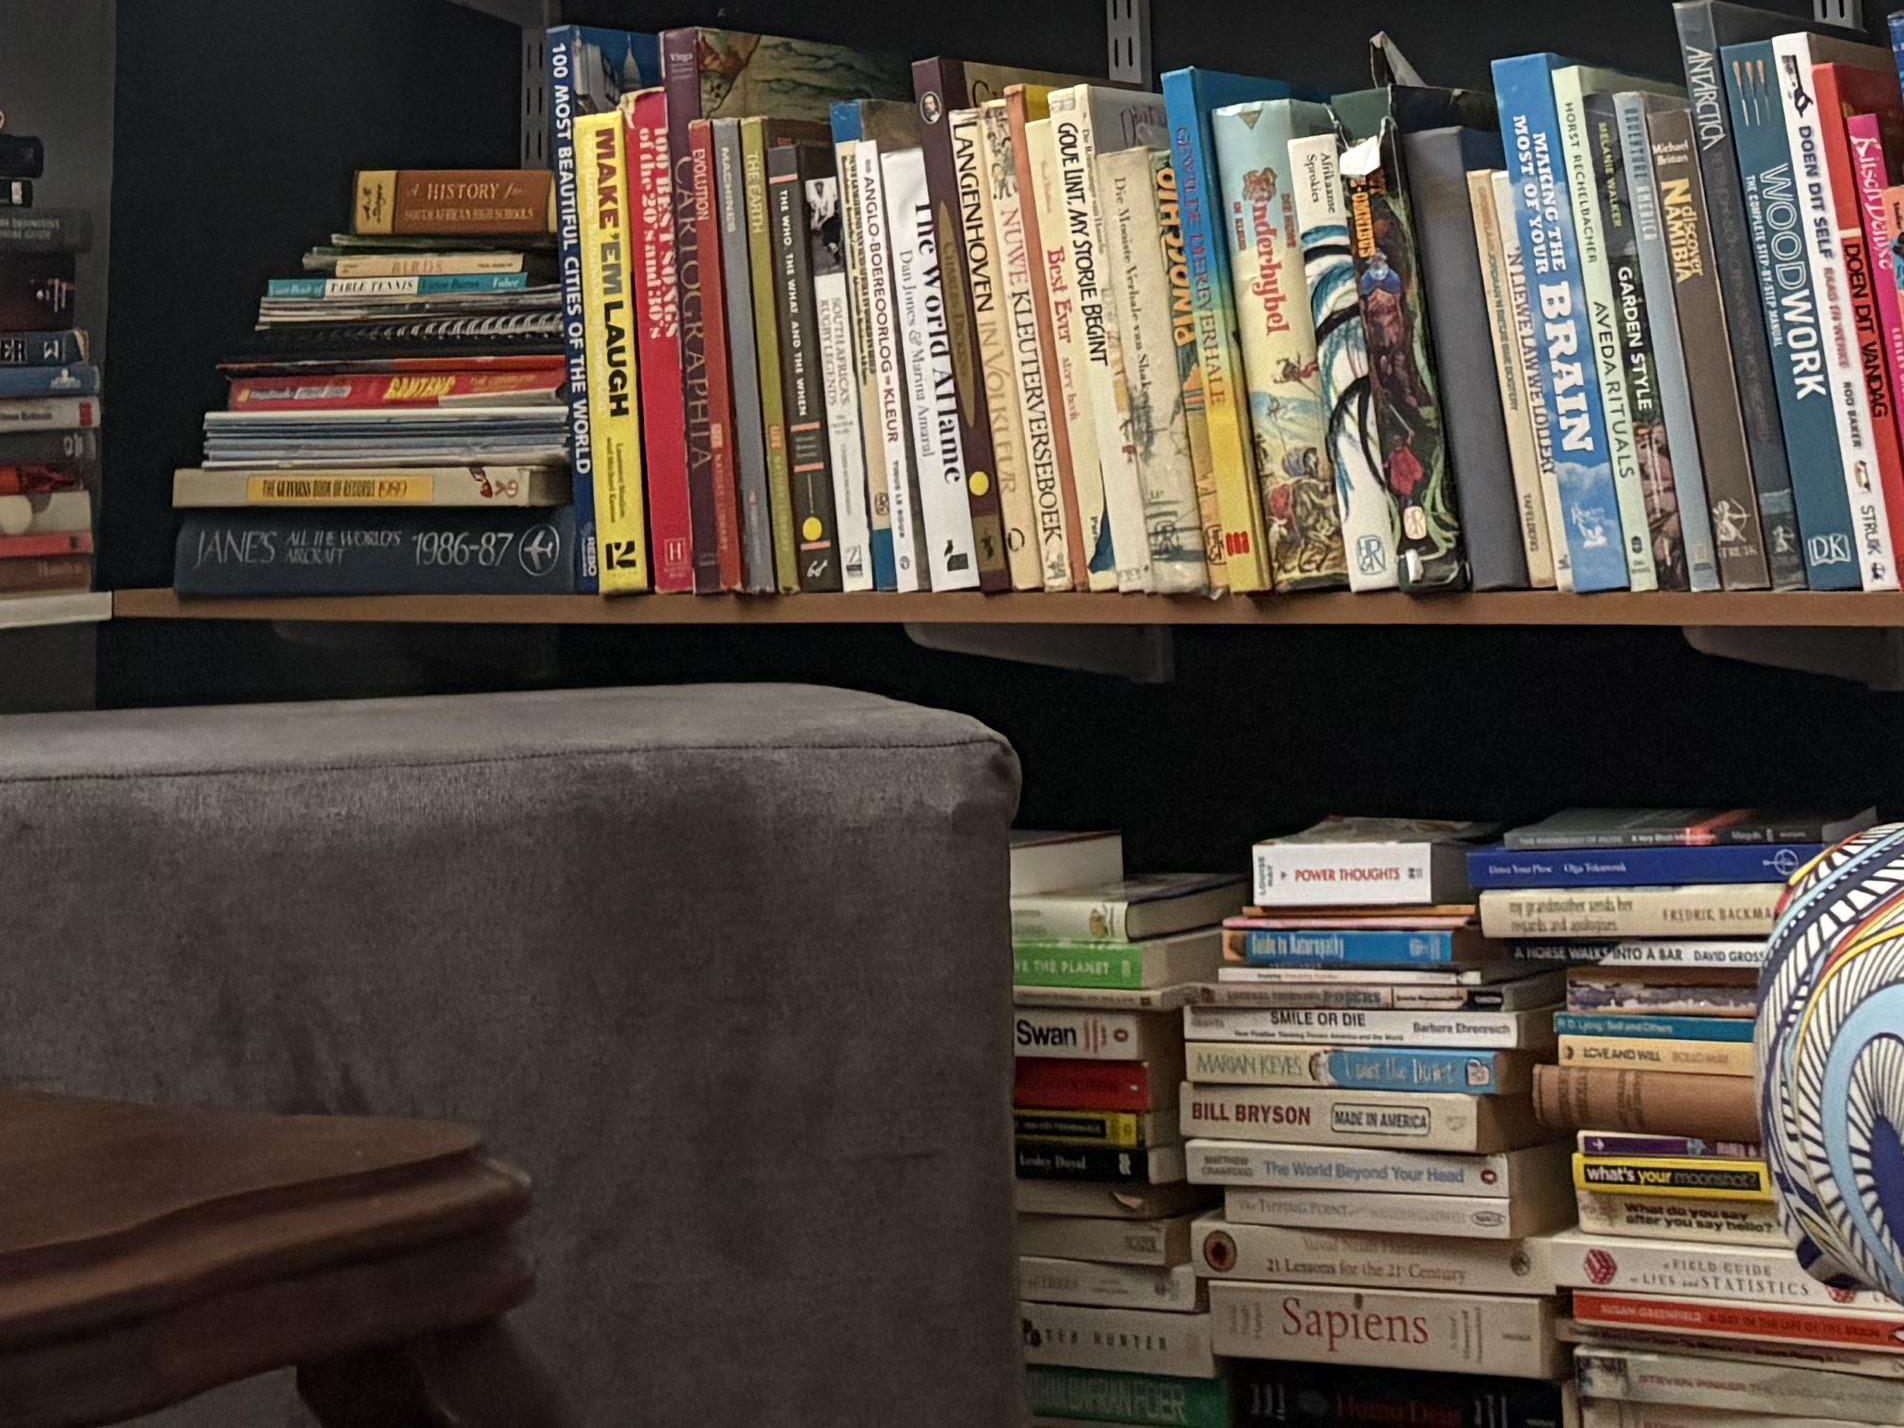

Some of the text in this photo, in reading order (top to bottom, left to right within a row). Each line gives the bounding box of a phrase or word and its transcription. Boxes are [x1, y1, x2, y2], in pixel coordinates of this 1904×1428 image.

[953, 122, 994, 314] LANGENHOVEN
[595, 127, 630, 418] MAKE 'EM LAUGH
[1759, 162, 1828, 400] WOODWORK
[1617, 265, 1653, 412] GARDEN STYLE
[1538, 281, 1594, 454] BRAIN
[1592, 300, 1634, 480] AVEDA RITUALS
[412, 531, 514, 566] 1986-87
[1810, 535, 1849, 566] DK
[1294, 866, 1401, 883] POWER THOUGHTS
[1016, 1020, 1077, 1046] Swan
[1270, 1010, 1367, 1028] SMILE OR DIE
[1192, 1101, 1311, 1127] BILL BRYSON
[1281, 1296, 1430, 1352] Sapiens
